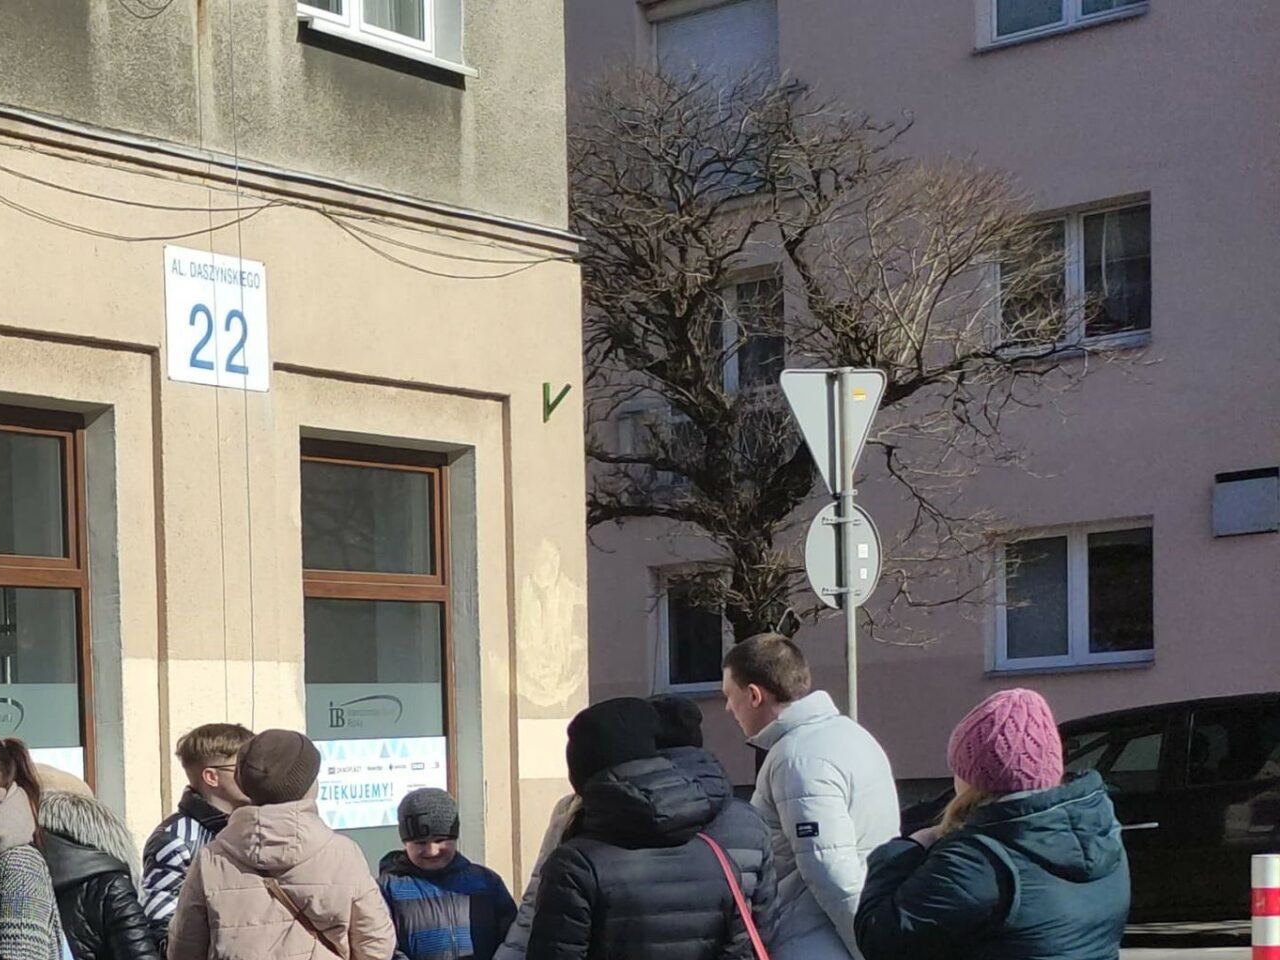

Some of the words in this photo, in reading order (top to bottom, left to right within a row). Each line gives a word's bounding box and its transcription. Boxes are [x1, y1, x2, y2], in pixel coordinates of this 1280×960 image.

[171, 258, 187, 277] AL.
[189, 261, 261, 289] DASZYŃSKIEGO
[189, 303, 249, 375] 22
[320, 782, 394, 804] ZIĘKUJEMY!
